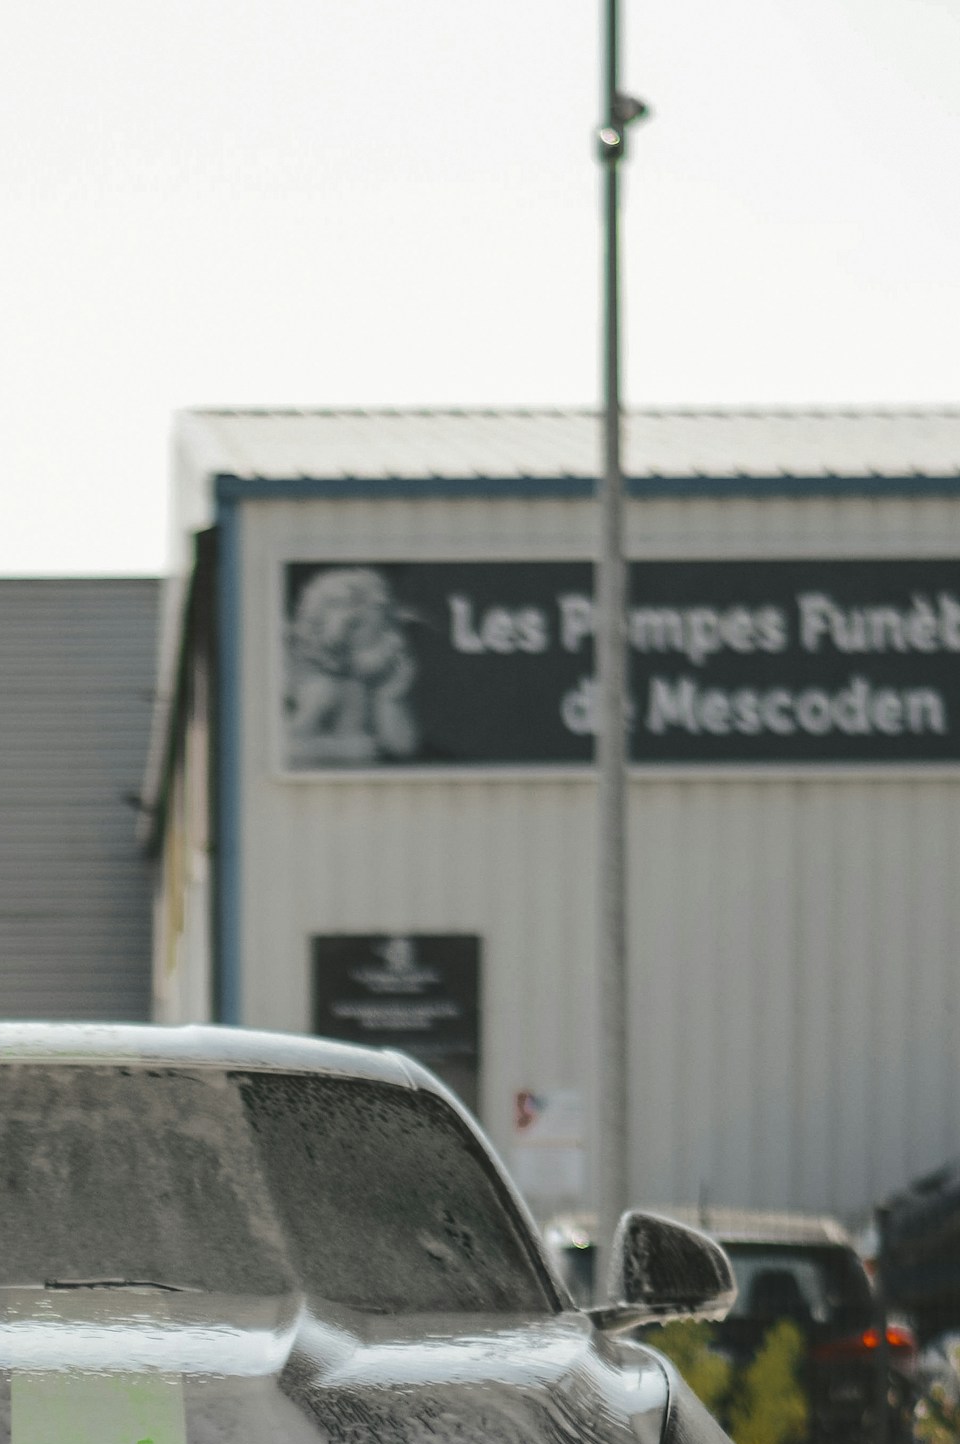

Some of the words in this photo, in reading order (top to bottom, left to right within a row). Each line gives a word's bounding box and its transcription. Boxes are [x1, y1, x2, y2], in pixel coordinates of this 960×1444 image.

[449, 595, 547, 653] Les
[558, 593, 787, 666] Pmpes
[561, 677, 635, 735] d
[647, 677, 944, 734] Mescoden
